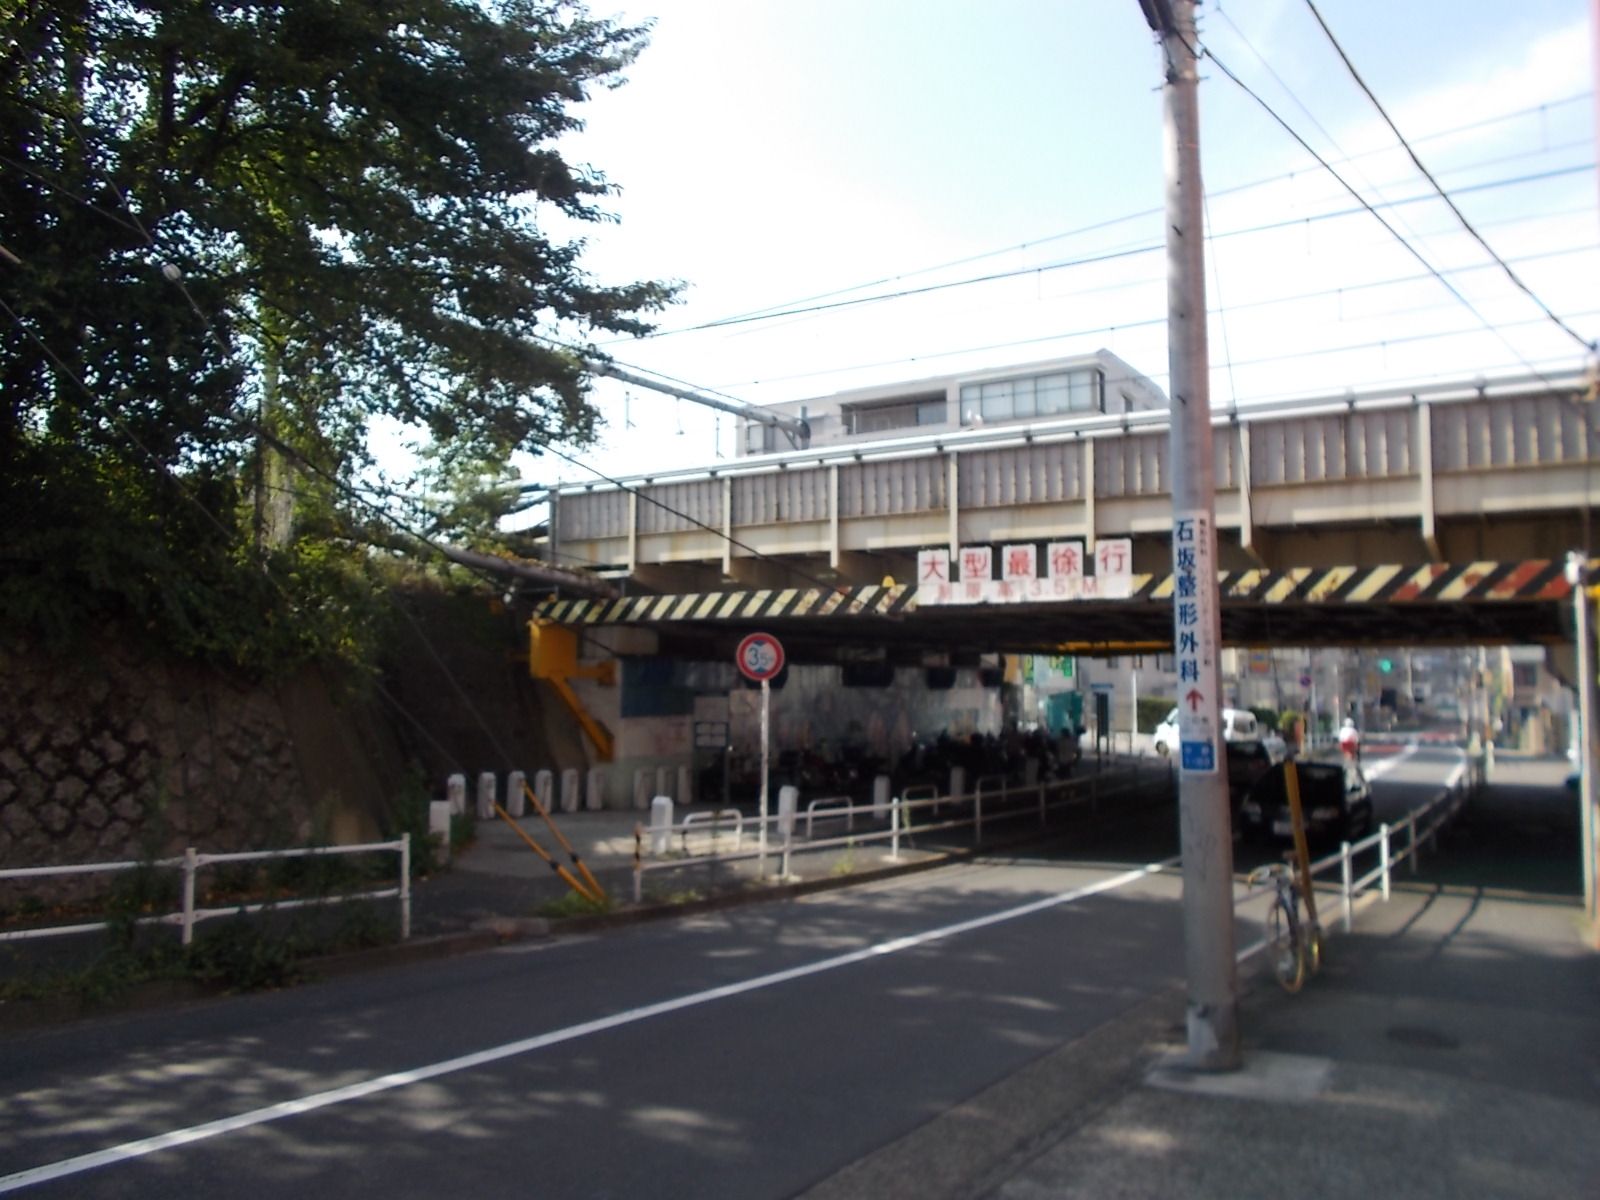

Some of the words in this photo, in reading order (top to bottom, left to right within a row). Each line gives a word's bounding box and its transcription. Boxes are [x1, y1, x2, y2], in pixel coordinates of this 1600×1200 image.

[921, 543, 1128, 580] 大型最徐行
[1176, 519, 1200, 682] 石坂整形外科
